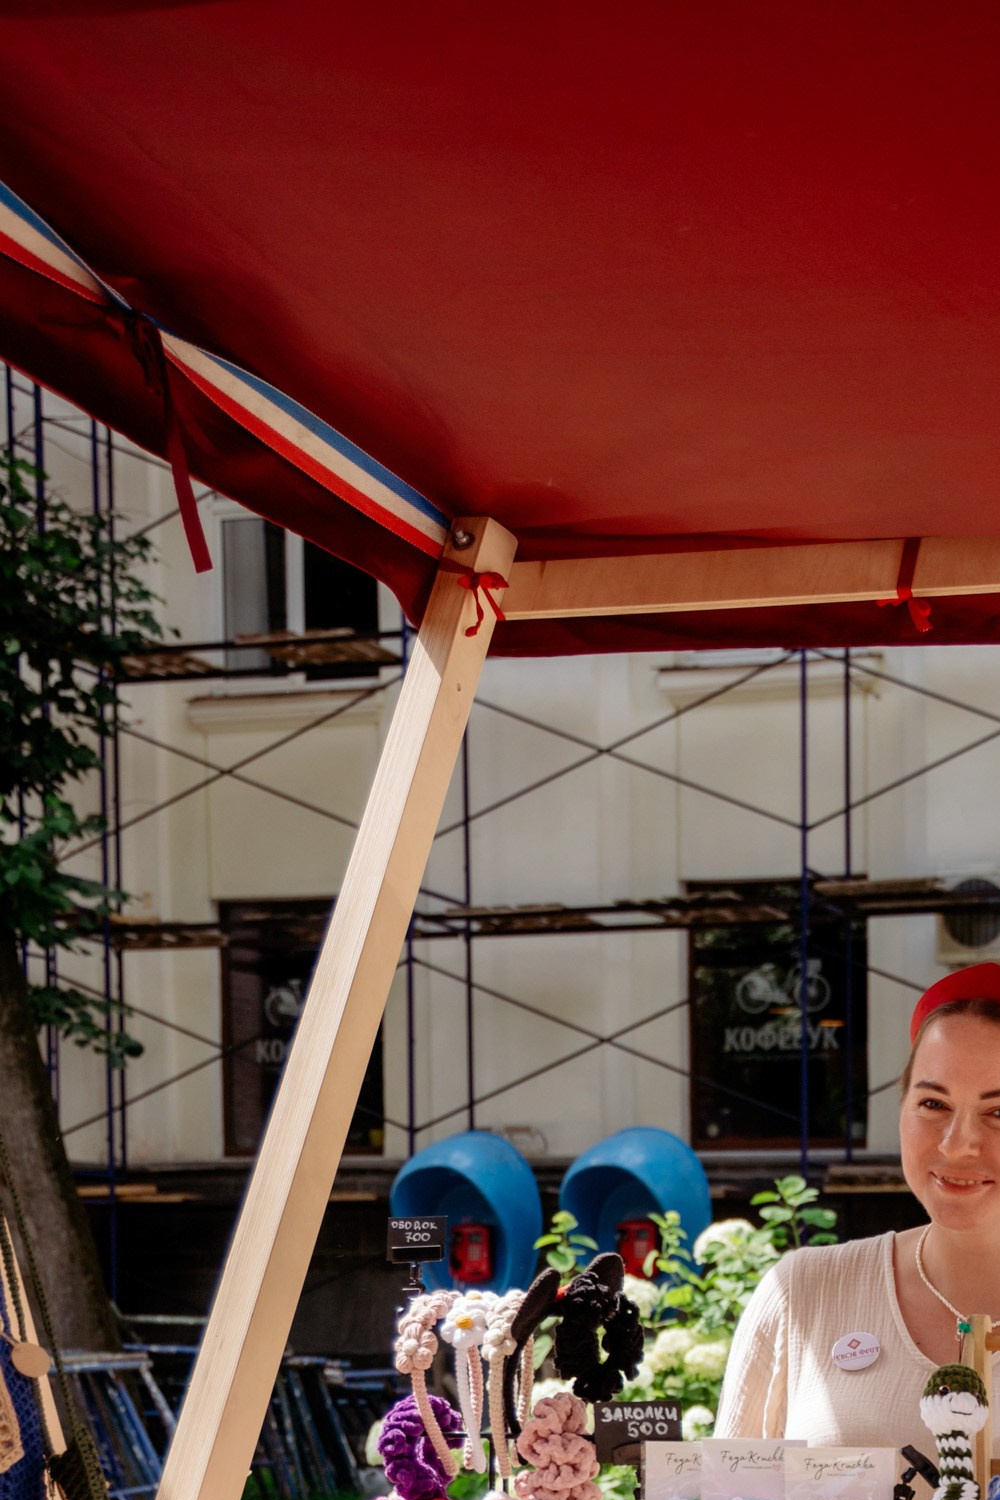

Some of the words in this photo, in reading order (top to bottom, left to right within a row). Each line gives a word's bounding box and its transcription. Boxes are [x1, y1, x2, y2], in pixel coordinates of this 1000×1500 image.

[405, 1232, 431, 1243] 700
[601, 1405, 678, 1423] ЗАКОЛКИ
[627, 1421, 669, 1438] 500
